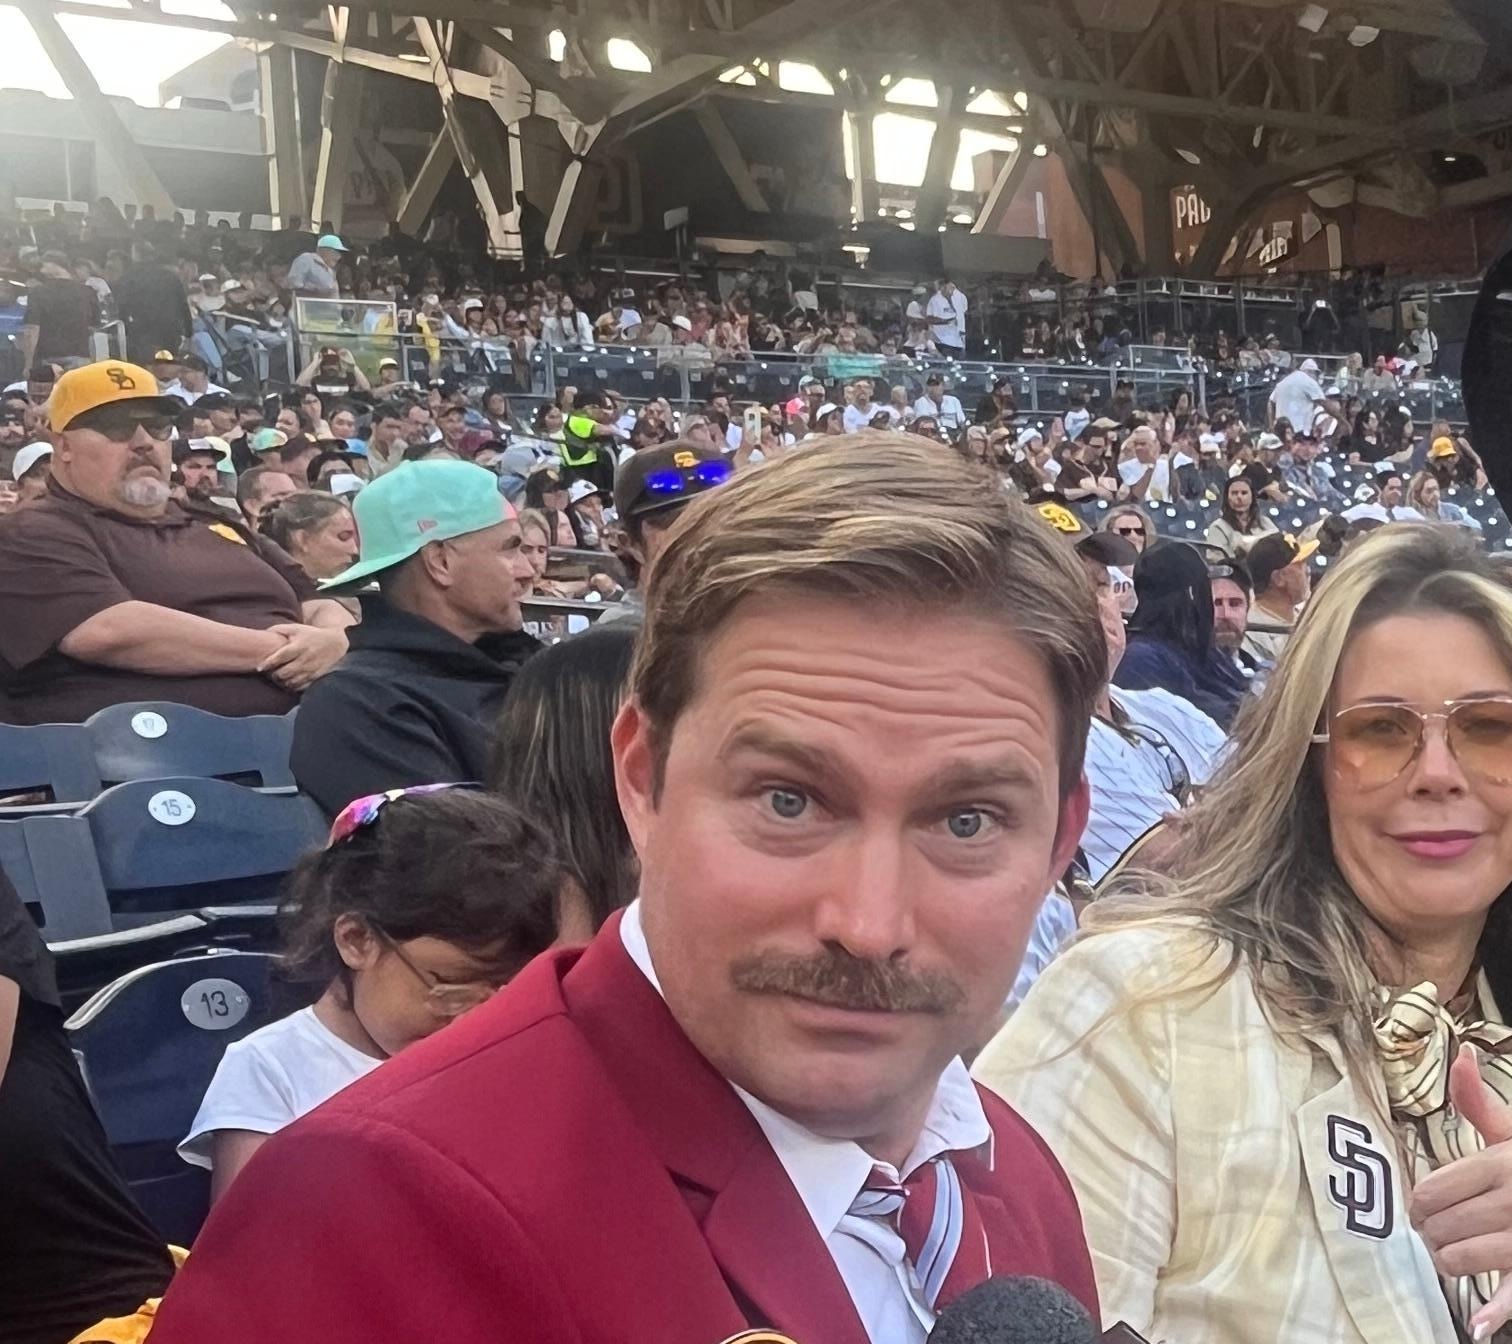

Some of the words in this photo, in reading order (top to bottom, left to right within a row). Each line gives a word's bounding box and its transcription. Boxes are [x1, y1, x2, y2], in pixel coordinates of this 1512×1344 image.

[161, 798, 182, 817] 15
[201, 990, 229, 1019] 13
[1326, 1114, 1394, 1241] SD
